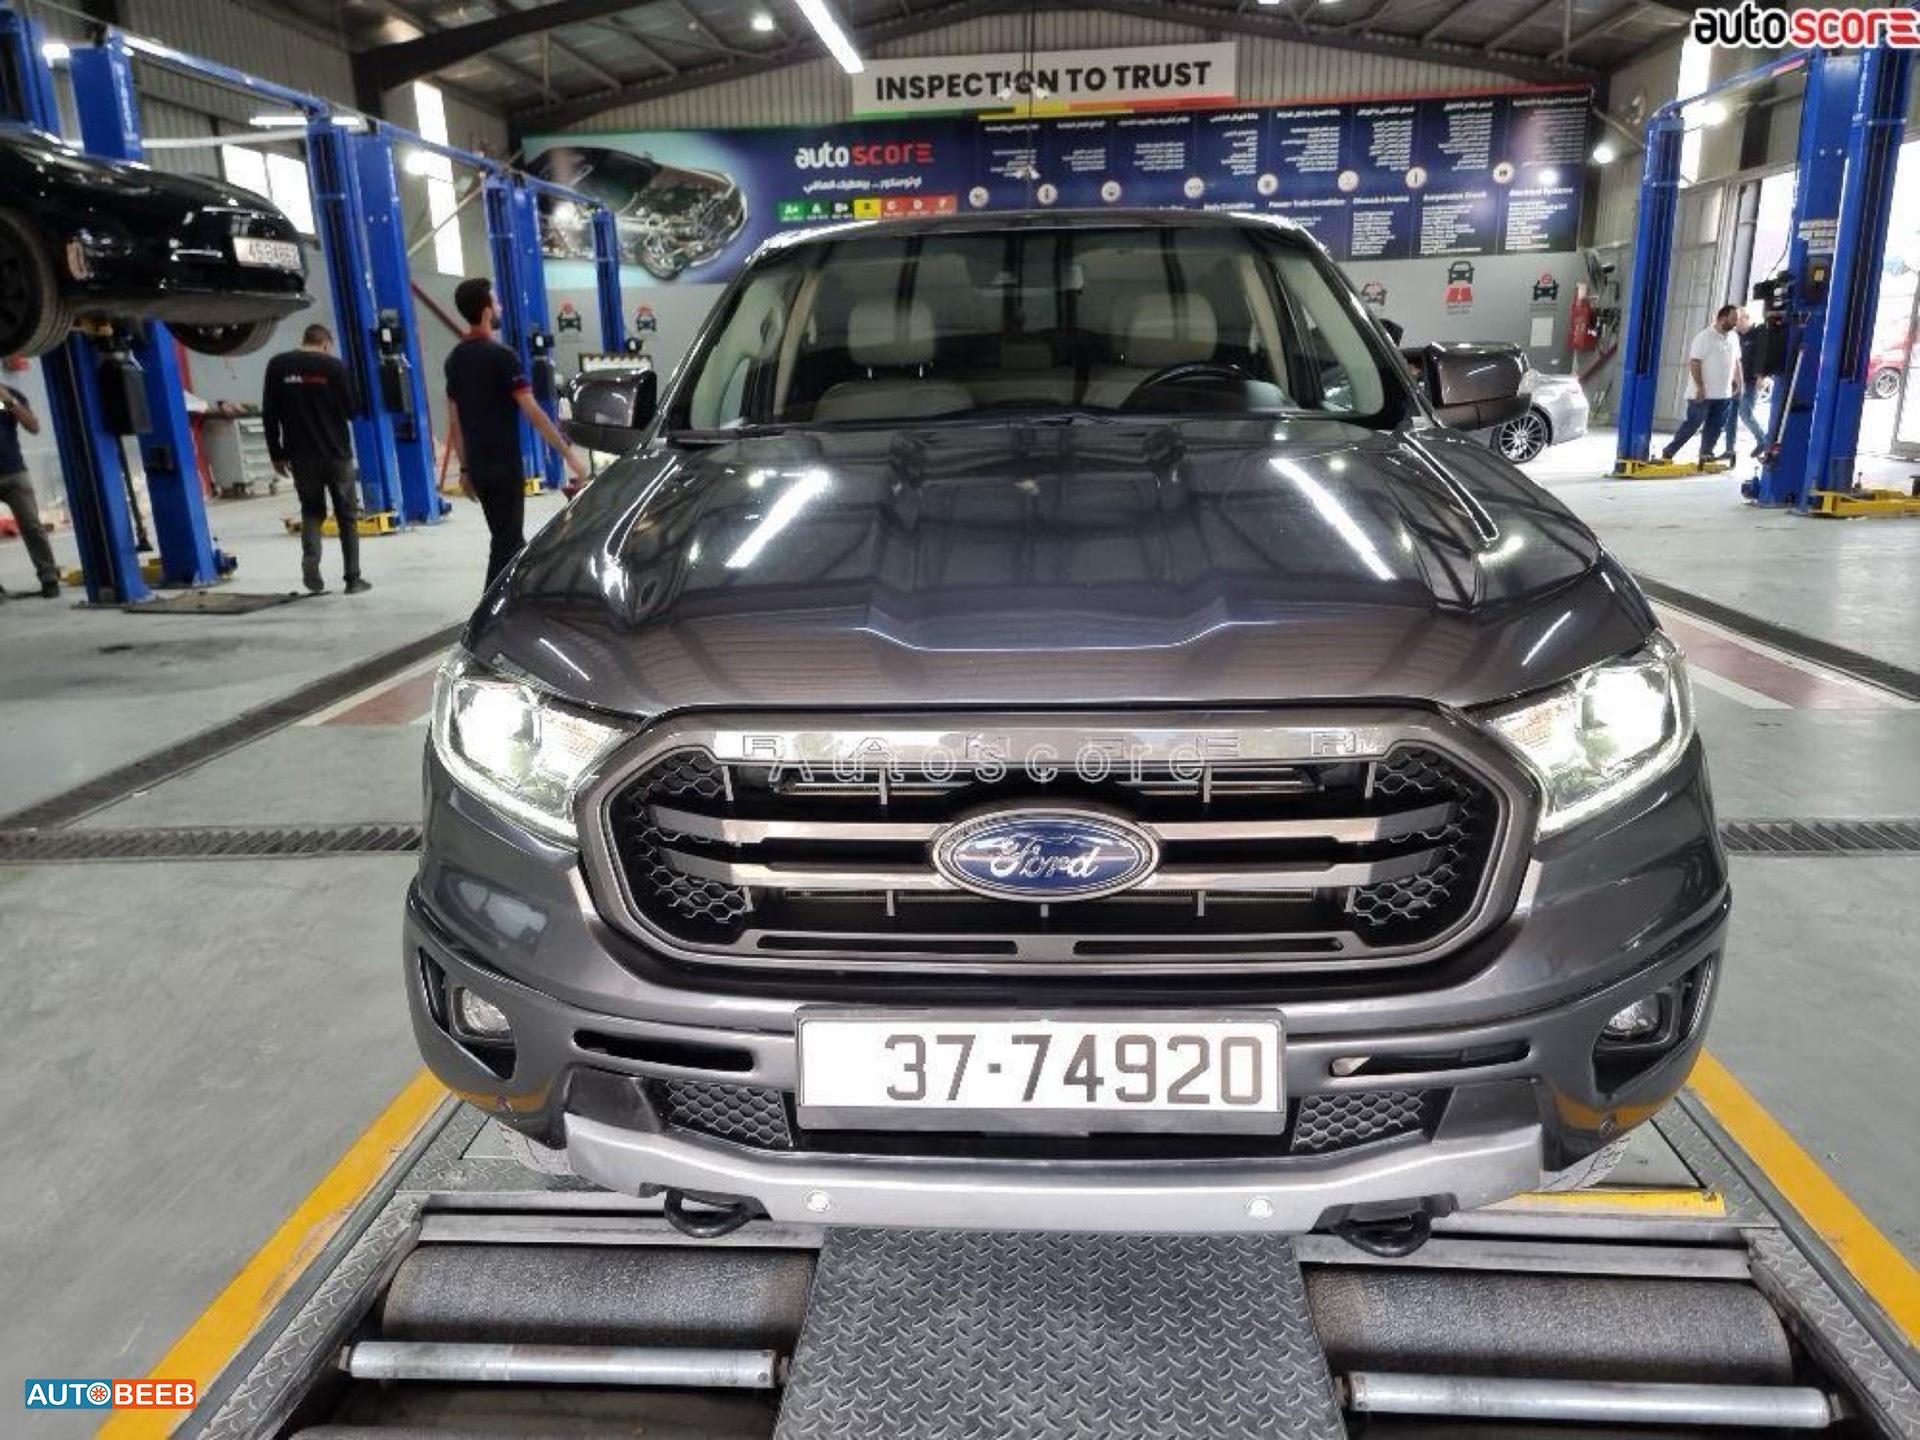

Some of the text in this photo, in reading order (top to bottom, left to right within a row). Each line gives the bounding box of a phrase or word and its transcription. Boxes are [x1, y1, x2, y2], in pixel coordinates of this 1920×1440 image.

[876, 60, 1212, 101] INSPECTION TO TRUST
[990, 834, 1101, 878] Ford
[884, 1033, 1263, 1105] 37-74920
